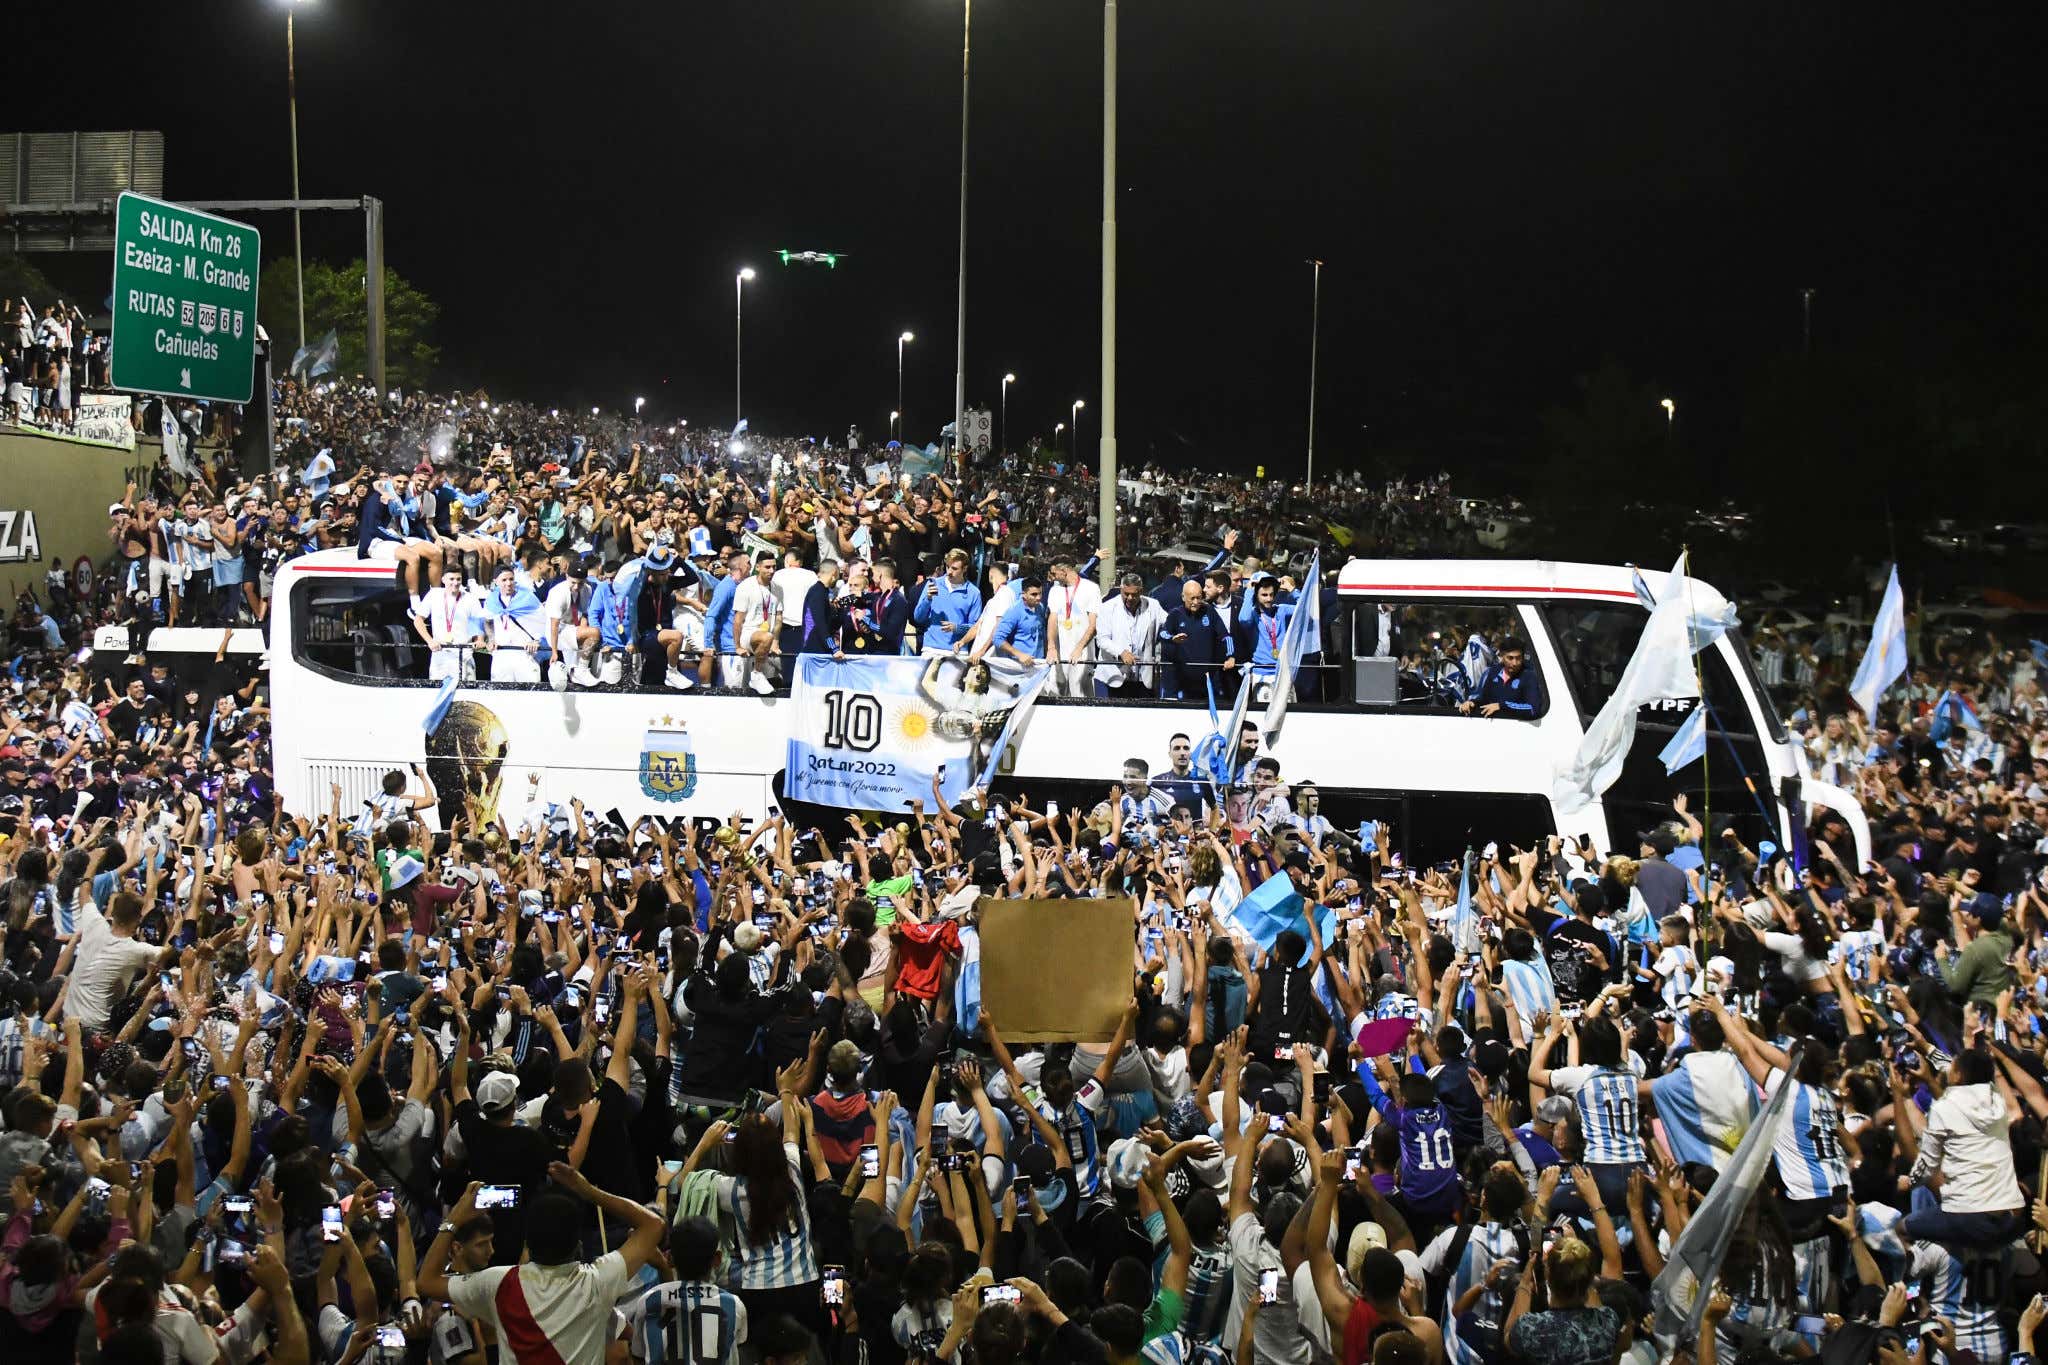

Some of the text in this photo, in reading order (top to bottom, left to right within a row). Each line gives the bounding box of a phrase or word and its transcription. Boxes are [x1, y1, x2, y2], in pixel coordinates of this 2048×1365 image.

[140, 211, 241, 259] SALIDA Km 26
[125, 241, 172, 275] Ezeiza
[184, 255, 200, 281] M.
[204, 260, 250, 292] Grande
[128, 289, 241, 333] RUTAS 52 205 6 3
[155, 328, 218, 360] Cañuelas
[825, 690, 882, 752] 10
[1649, 699, 1691, 712] YPF
[1603, 1097, 1633, 1139] 10
[1414, 1127, 1454, 1170] 10
[668, 1286, 712, 1300] MESSI
[656, 1304, 728, 1365] 10
